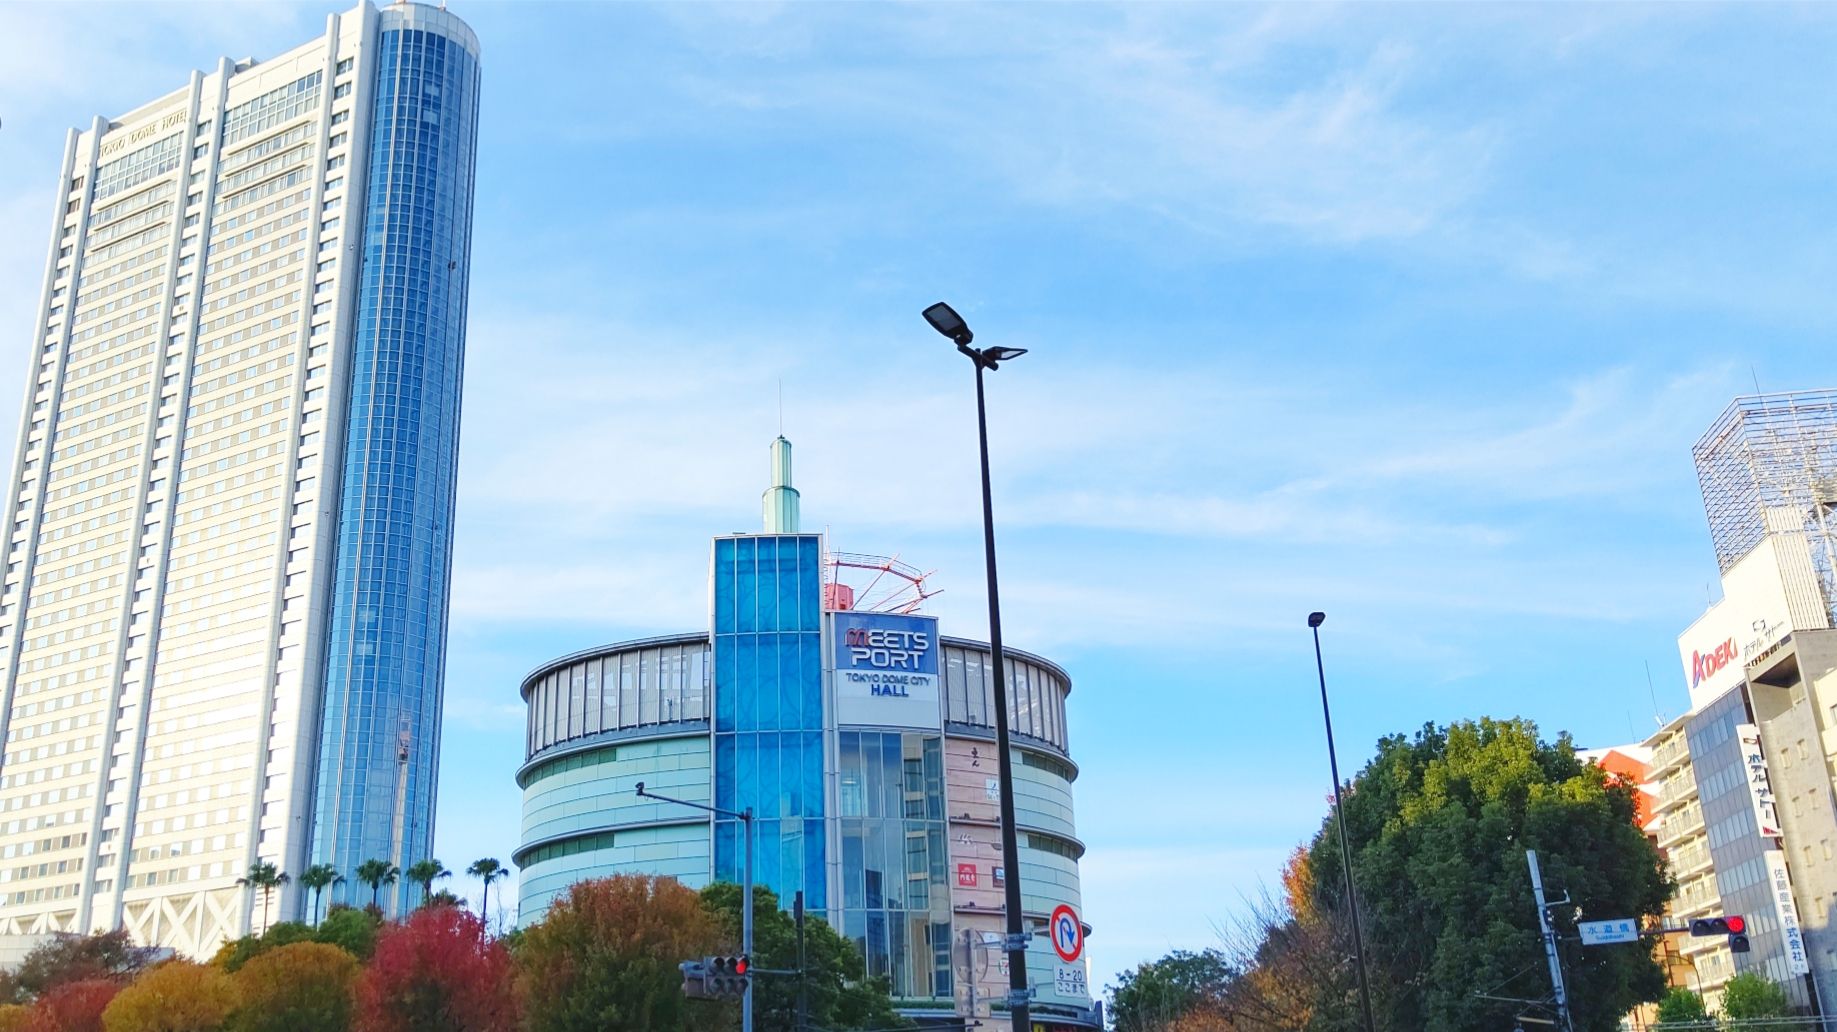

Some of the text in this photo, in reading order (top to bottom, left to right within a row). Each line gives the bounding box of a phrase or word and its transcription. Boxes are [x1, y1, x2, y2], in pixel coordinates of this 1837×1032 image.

[845, 627, 929, 650] MEETS
[851, 647, 924, 669] PORT
[845, 672, 931, 686] TOKYO DOME CITY
[871, 683, 909, 697] HALL
